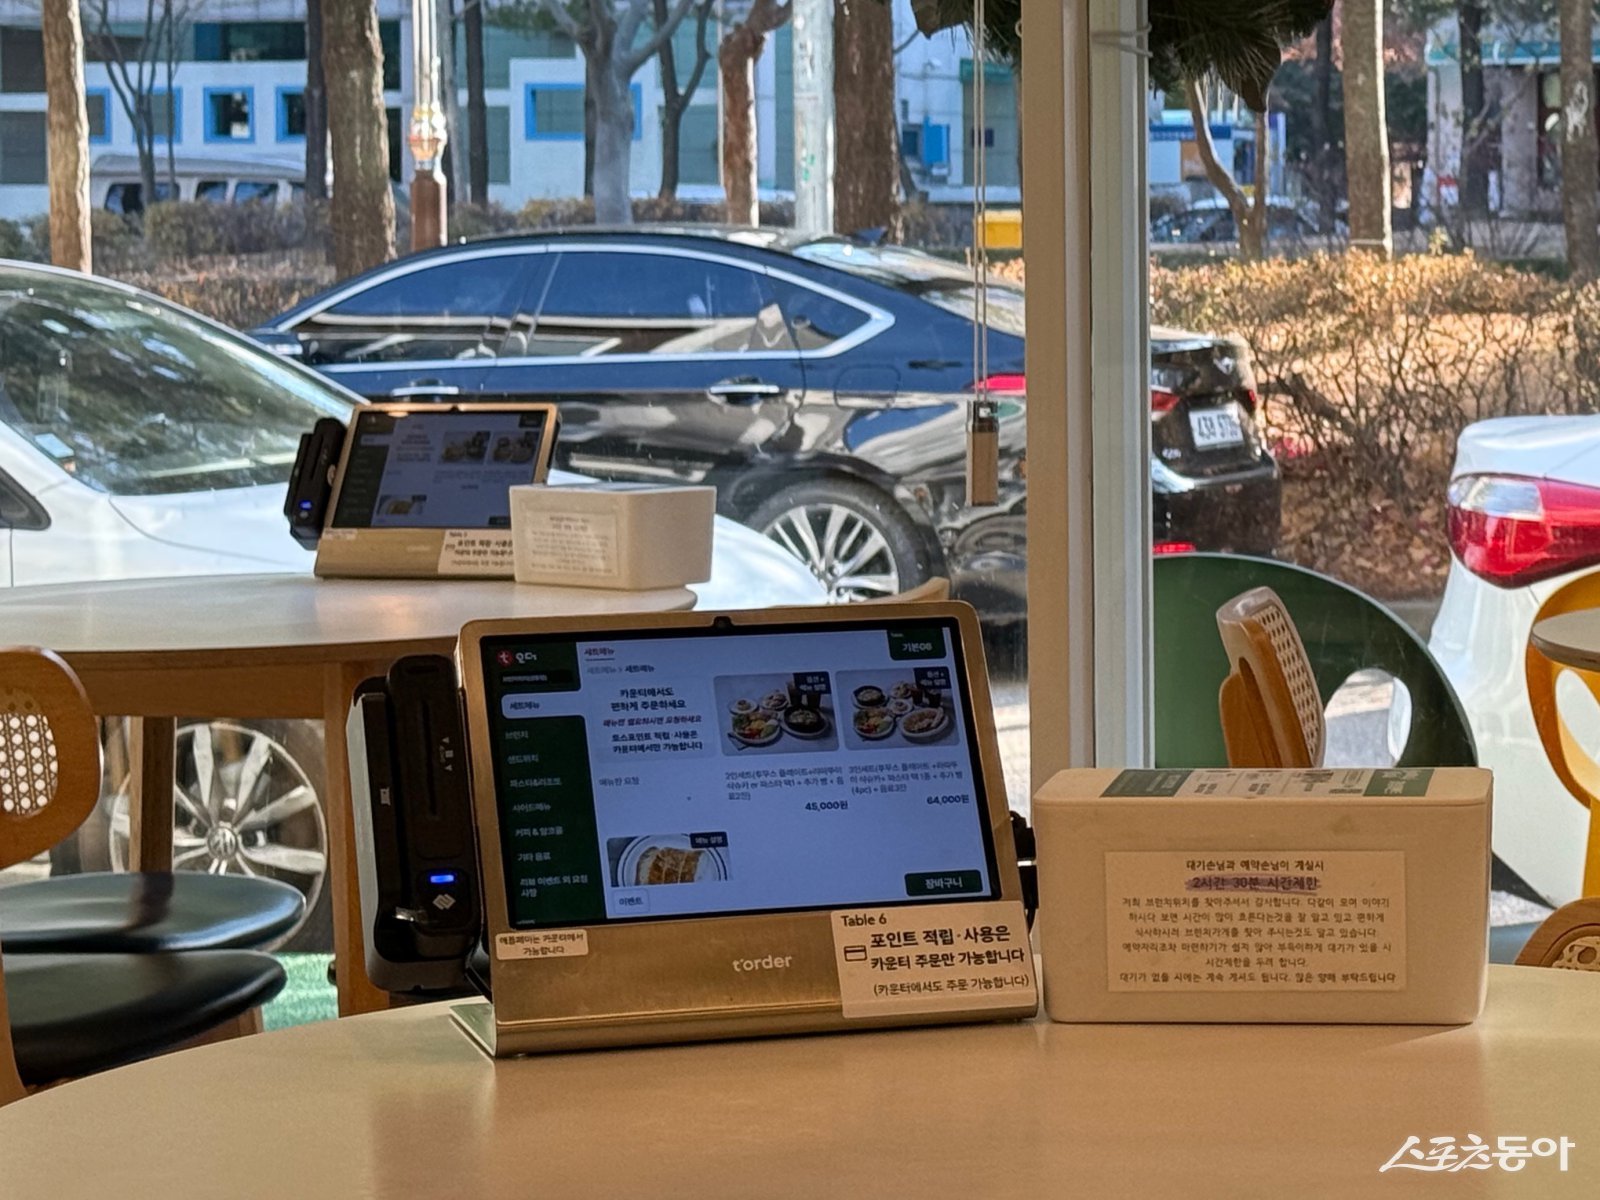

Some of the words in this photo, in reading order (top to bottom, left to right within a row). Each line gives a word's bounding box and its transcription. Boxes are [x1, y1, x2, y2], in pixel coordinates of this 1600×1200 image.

[620, 687, 674, 698] 카운터에서도
[610, 701, 639, 712] 편하게
[641, 699, 687, 711] 주문하세요
[663, 741, 703, 751] 가능합니다
[926, 794, 969, 805] 64,000원
[804, 800, 849, 812] 45,000원
[1186, 859, 1235, 871] 대기손님과
[1240, 859, 1289, 871] 예약손님이
[1294, 859, 1324, 871] 계실시
[1191, 876, 1225, 890] 2시간
[1231, 876, 1259, 890] 30분
[1267, 876, 1317, 890] 시간제한
[1122, 897, 1140, 908] 저희
[1204, 897, 1250, 908] 찾아주셔서
[1307, 897, 1334, 908] 다같이
[1339, 897, 1357, 908] 모여
[1362, 897, 1389, 908] 이야기
[840, 914, 875, 927] Table
[878, 914, 887, 925] 6
[1129, 912, 1156, 923] 하시다
[1160, 912, 1178, 923] 보면
[1183, 912, 1210, 923] 시간이
[1215, 912, 1233, 923] 많이
[1298, 912, 1306, 923] 잘
[1311, 912, 1329, 923] 알고
[1333, 912, 1352, 923] 있고
[1357, 912, 1385, 923] 편하게
[1244, 927, 1263, 938] 찾아
[1316, 927, 1335, 938] 알고
[499, 935, 540, 945] 애플페이는
[542, 933, 584, 943] 카운터에서
[870, 930, 919, 949] 포인트
[523, 945, 564, 956] 가능합니다
[1231, 942, 1250, 953] 쉽지
[1254, 942, 1273, 953] 않아
[1327, 942, 1355, 953] 대기가
[1383, 942, 1391, 953] 시
[870, 955, 911, 971] 카운터
[914, 953, 955, 969] 주문만
[958, 948, 1025, 966] 가능합니다
[1205, 957, 1250, 968] 시간제한을
[1120, 972, 1147, 983] 대기가
[1151, 972, 1169, 983] 없을
[1174, 972, 1202, 983] 시에는
[1206, 972, 1224, 983] 계속
[873, 978, 943, 997] (카운터에서도
[946, 978, 970, 991] 주문
[971, 974, 1030, 991] 가능합니다)
